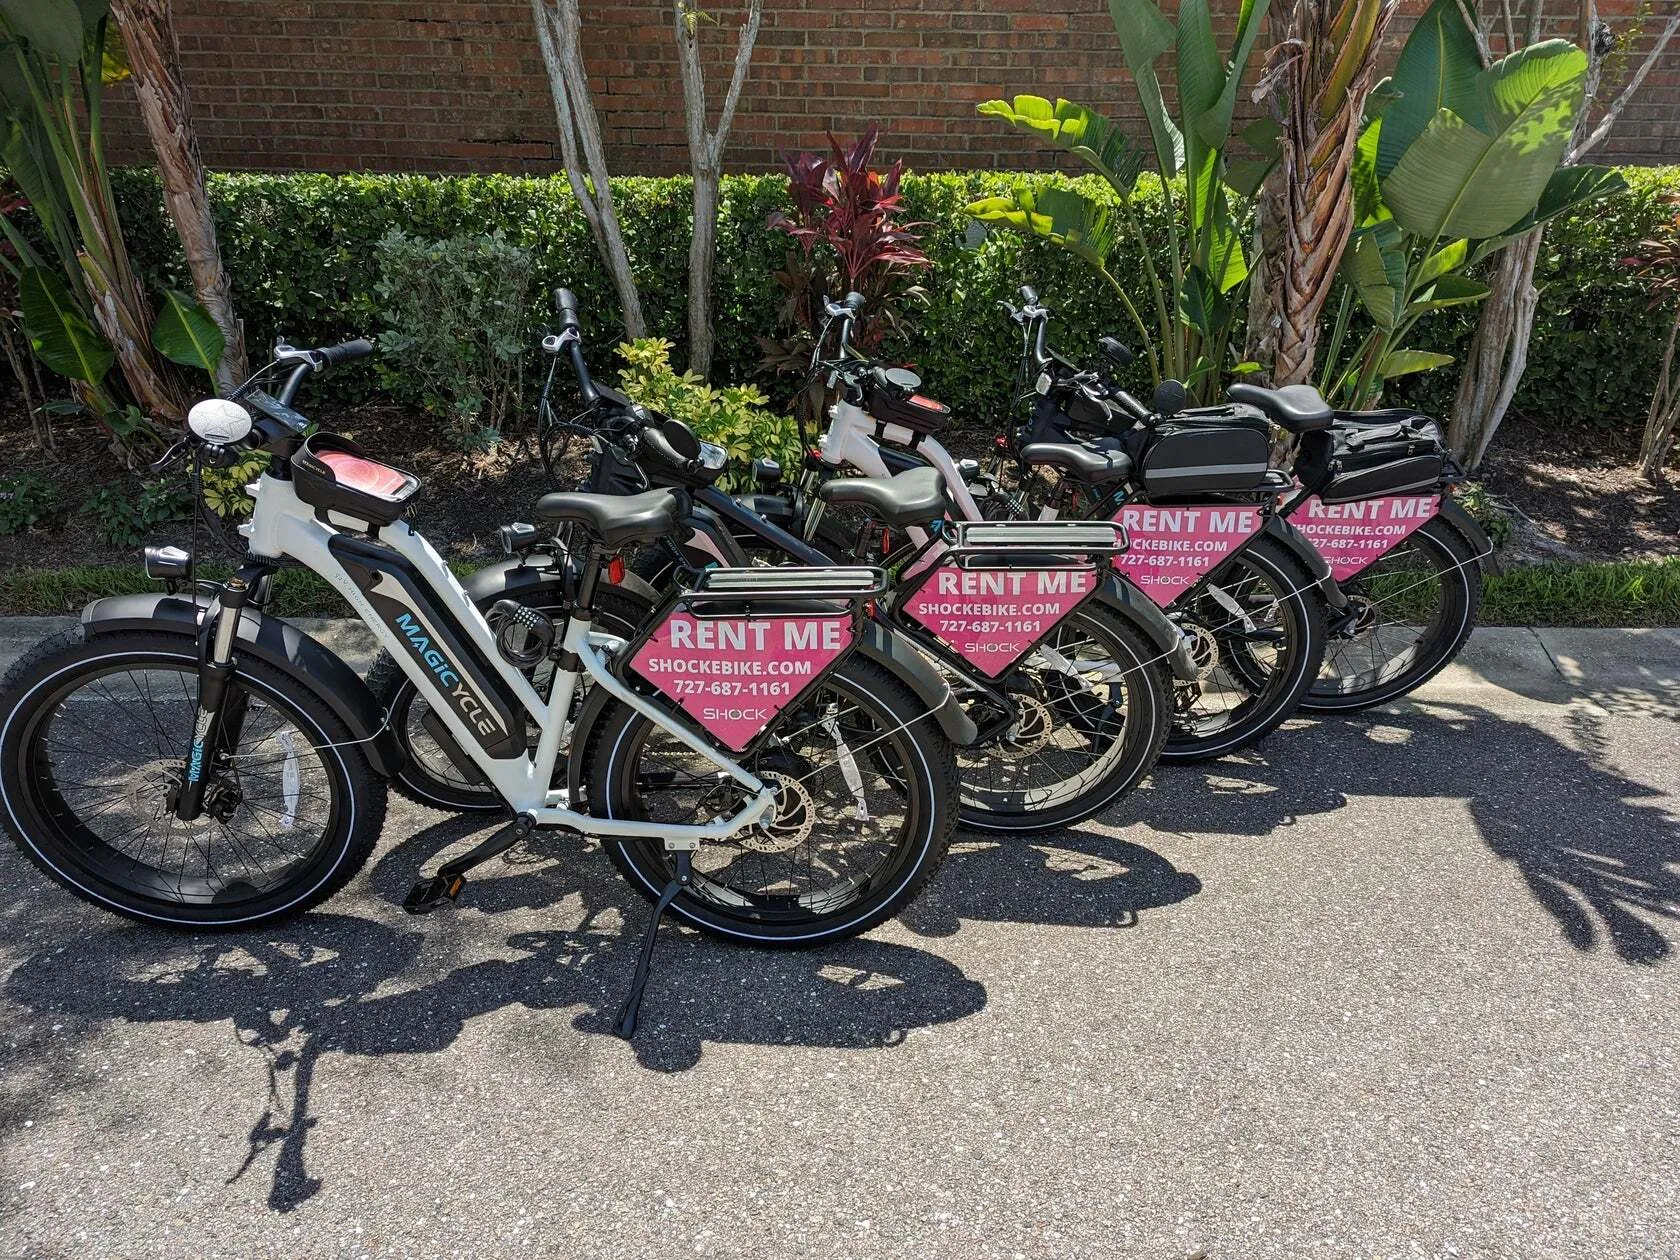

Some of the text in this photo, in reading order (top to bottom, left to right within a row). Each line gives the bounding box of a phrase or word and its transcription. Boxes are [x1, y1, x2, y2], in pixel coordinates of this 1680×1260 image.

[1308, 498, 1433, 519] RENT ME
[1122, 510, 1253, 533] RENT ME
[1292, 524, 1406, 535] HOCKEBIKE.COM
[1308, 538, 1388, 549] 27-687-1161
[1120, 554, 1209, 567] 727-687-1161
[938, 571, 1087, 595] RENT ME
[1140, 575, 1190, 585] SHOCK
[918, 602, 1060, 616] SHOCKEBIKE.COM
[939, 620, 1041, 633] 727-687-1161
[670, 619, 841, 651] RENT ME
[964, 642, 1022, 653] SHOCK
[648, 658, 812, 676] SHOCKEBIKE.COM
[673, 679, 790, 696] 727-687-1161
[703, 707, 768, 721] SHOCK
